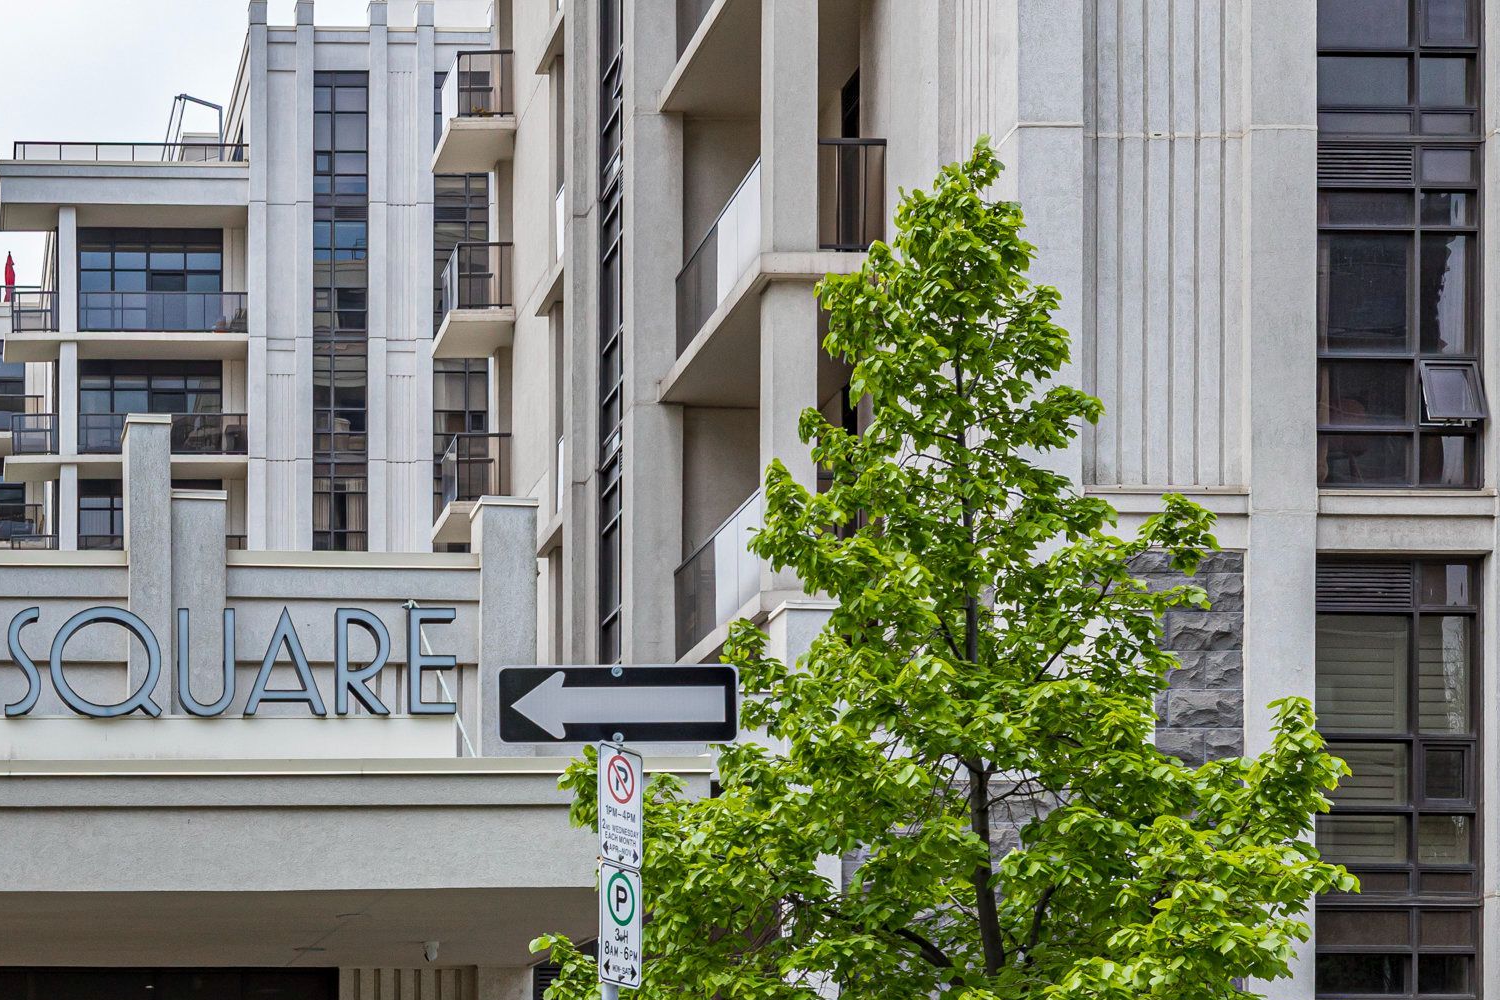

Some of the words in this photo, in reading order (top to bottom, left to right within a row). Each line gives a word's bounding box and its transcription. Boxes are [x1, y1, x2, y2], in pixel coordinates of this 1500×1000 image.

[4, 606, 457, 718] SQUARE
[605, 831, 618, 841] EACH
[619, 835, 637, 848] MONTH
[612, 824, 639, 839] WEDNESDAY
[616, 885, 627, 912] P
